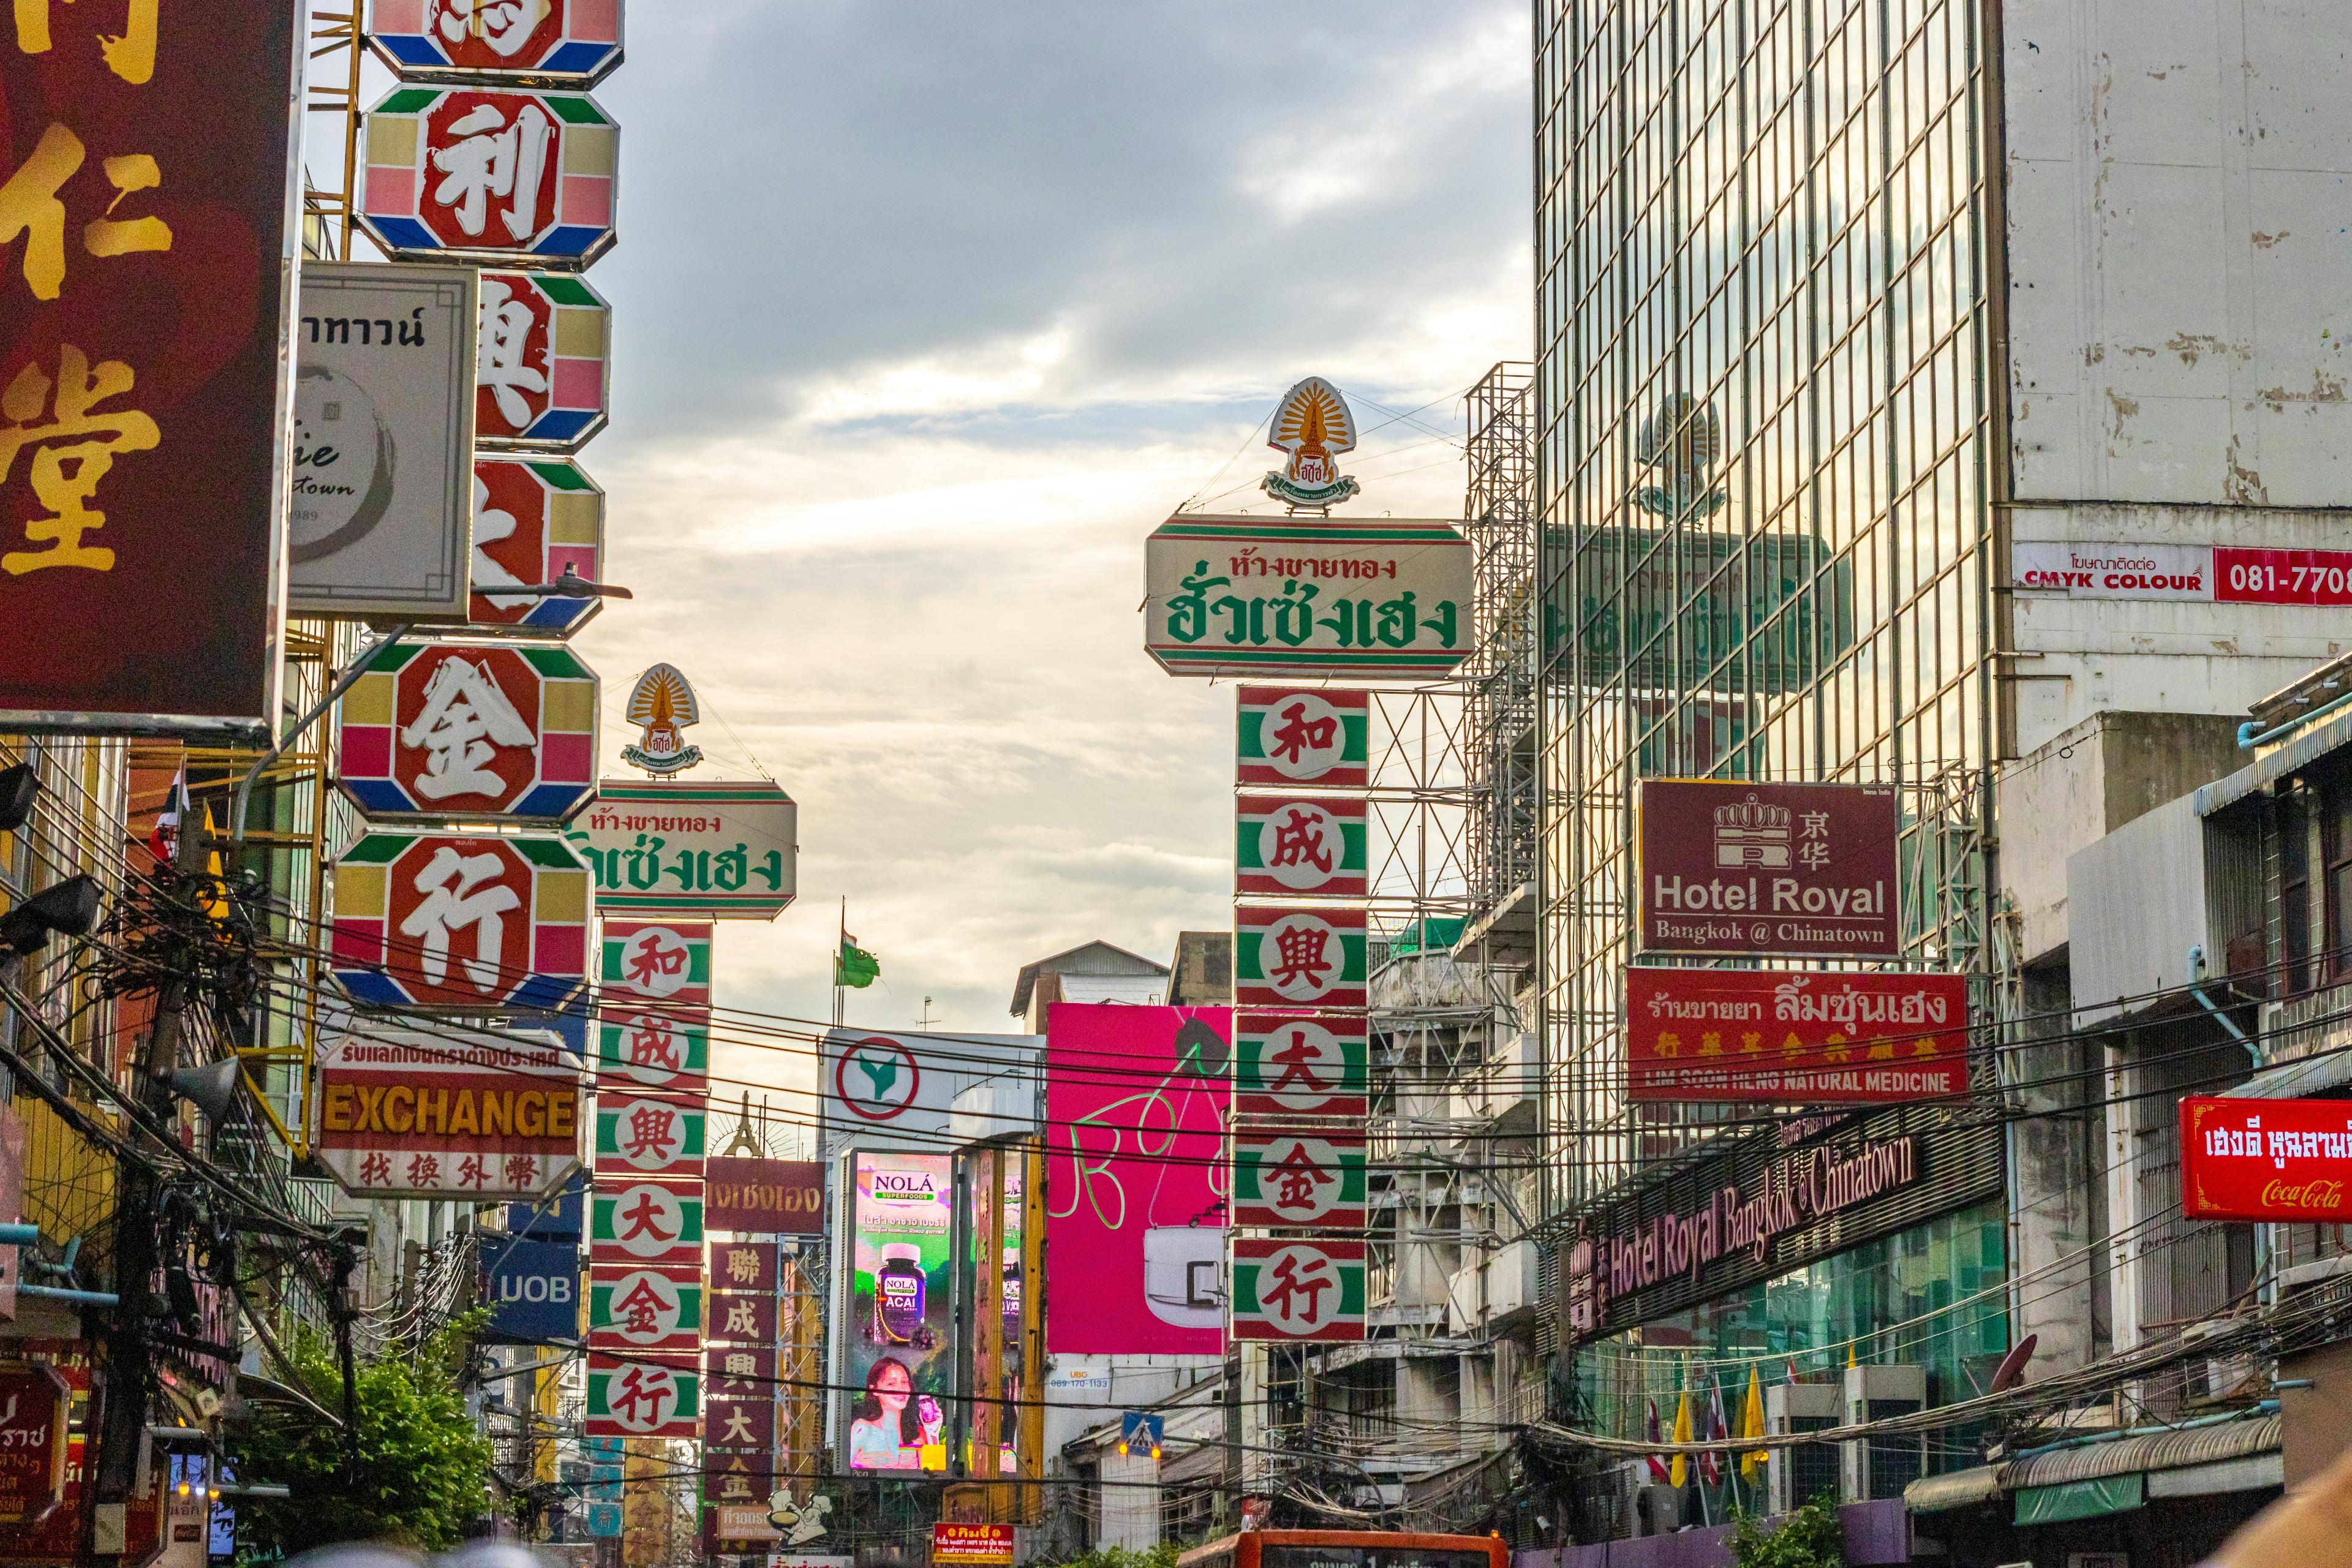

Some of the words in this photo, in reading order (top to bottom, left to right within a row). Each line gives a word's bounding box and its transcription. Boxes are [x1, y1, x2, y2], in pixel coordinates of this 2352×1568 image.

[298, 308, 426, 349] าทาวน์
[293, 475, 355, 496] town
[1229, 546, 1396, 579] ห้างขายทอง
[2024, 570, 2094, 588] CMYK
[2103, 574, 2202, 590] COLOUR
[1166, 559, 1457, 649] ฮั่วเซ่งเฮง
[590, 806, 721, 832] ห้างขายทอง
[1797, 810, 1831, 871] 京华
[1654, 875, 1757, 910] Hotel
[1773, 878, 1883, 915] Royal
[1656, 920, 1742, 944] Bangkok
[1750, 923, 1770, 944] @
[1777, 923, 1884, 943] Chinatown
[1261, 701, 1338, 1324] 和成興大金行
[1645, 1069, 1675, 1087] LIM
[1783, 1072, 1862, 1092] NATURAL
[1864, 1073, 1951, 1093] MEDICINE
[323, 1085, 576, 1139] EXCHANGE
[2267, 1120, 2352, 1169] หูฉลาม
[360, 1152, 540, 1192] 找換外幣
[875, 1174, 934, 1192] NOLÁ
[1610, 1217, 1659, 1298] Hotel
[1664, 1190, 1717, 1283] Royal
[1724, 1159, 1797, 1263] Bangkok
[1798, 1174, 1807, 1212] @
[1811, 1136, 1912, 1217] Chinatown
[500, 1275, 571, 1303] UOB
[886, 1297, 916, 1307] ACAI
